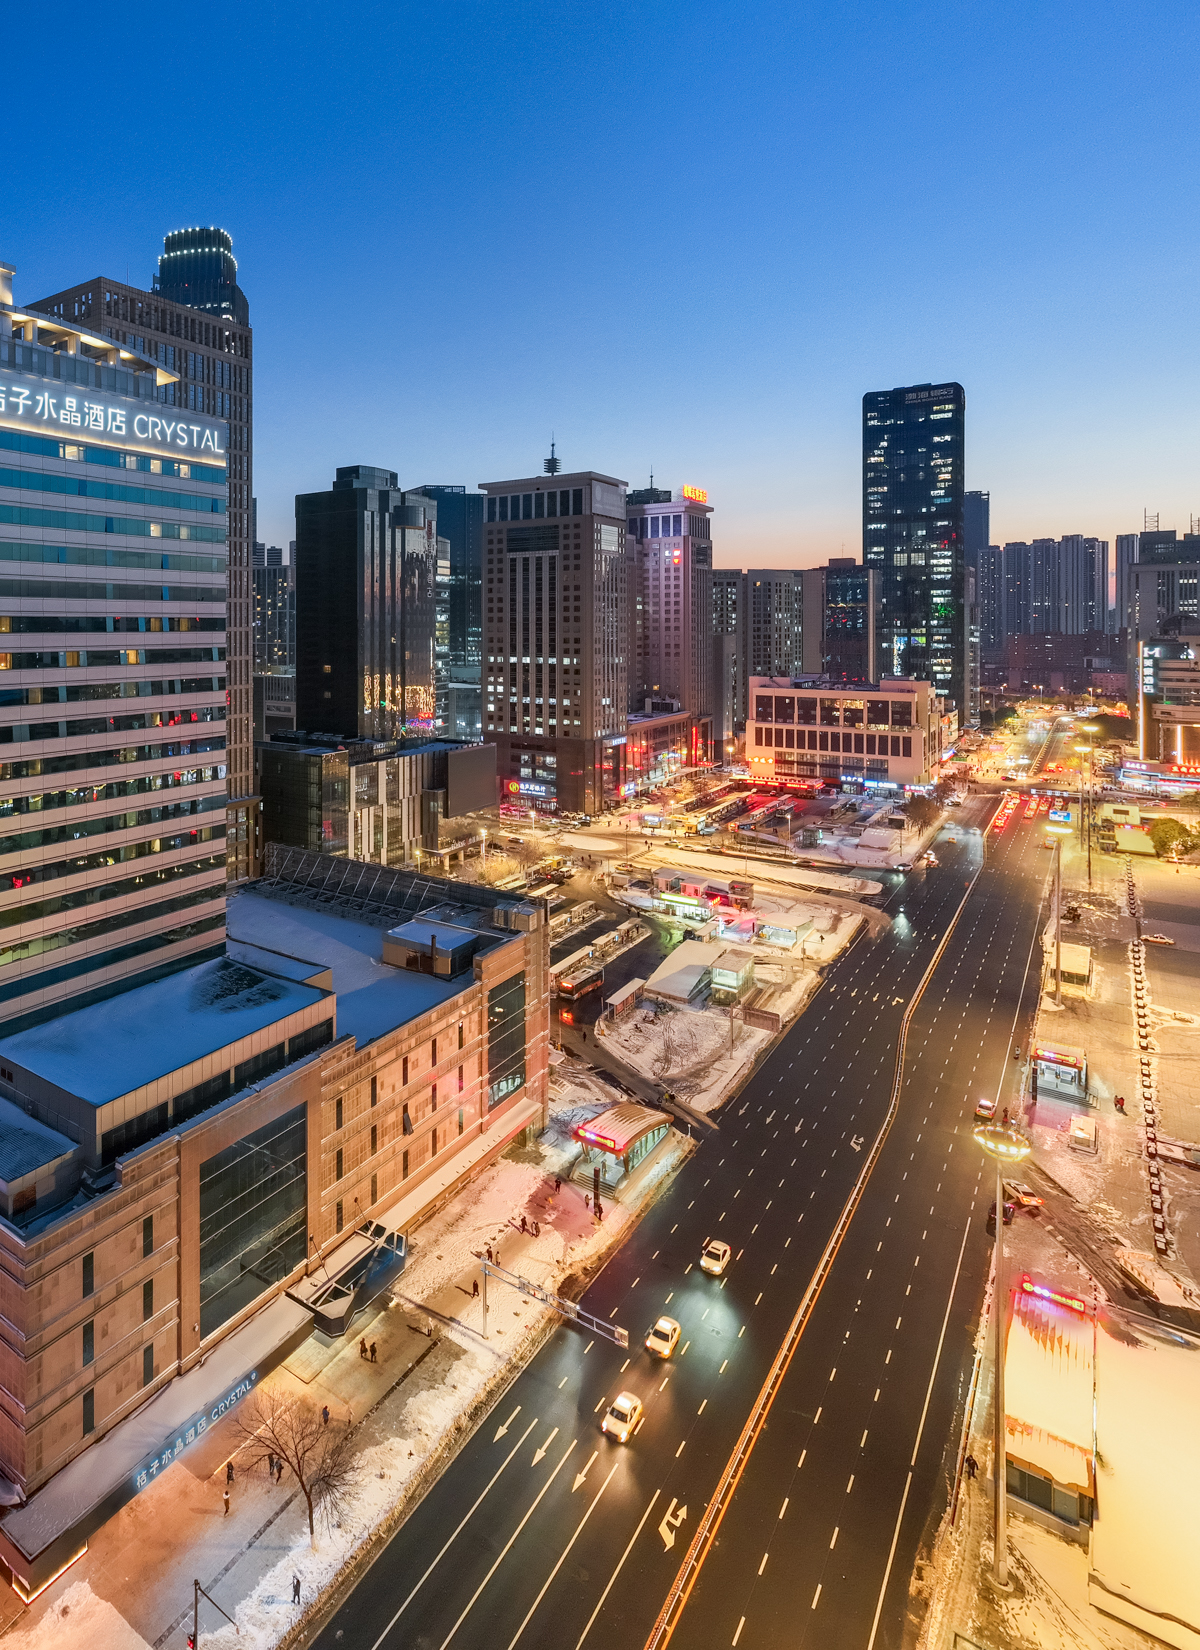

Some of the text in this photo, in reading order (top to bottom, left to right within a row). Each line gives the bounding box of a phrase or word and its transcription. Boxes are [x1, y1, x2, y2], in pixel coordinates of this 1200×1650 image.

[134, 414, 224, 453] CRYSTAL
[136, 1382, 252, 1487] 桔子水晶酒店 CRYSTAL
